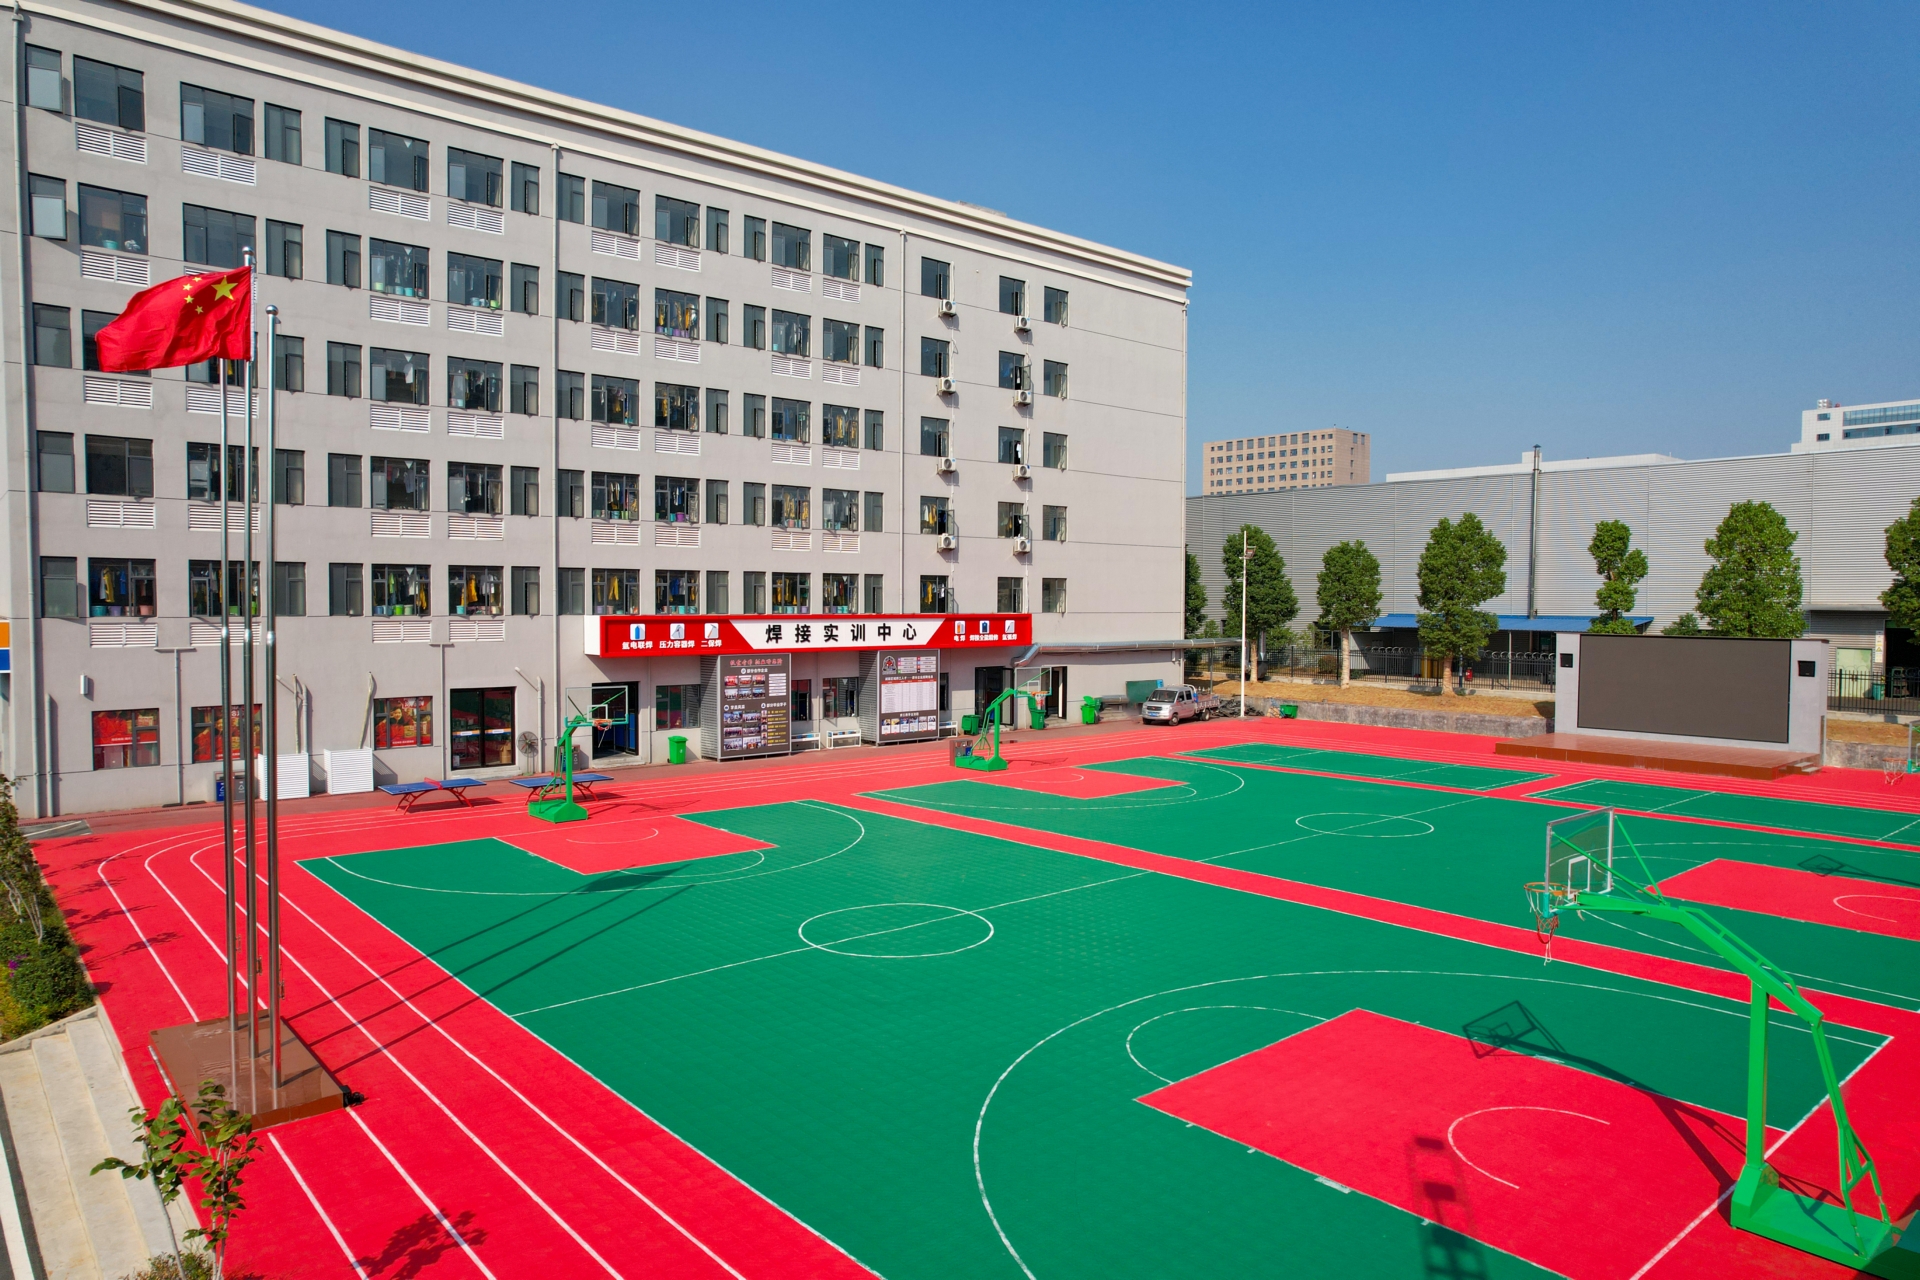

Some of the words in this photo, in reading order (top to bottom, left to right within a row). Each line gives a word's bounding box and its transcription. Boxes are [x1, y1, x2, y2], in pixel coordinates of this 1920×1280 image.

[765, 623, 917, 644] 焊接实训中心
[659, 640, 695, 648] 压力容器焊
[701, 639, 722, 648] 二保焊
